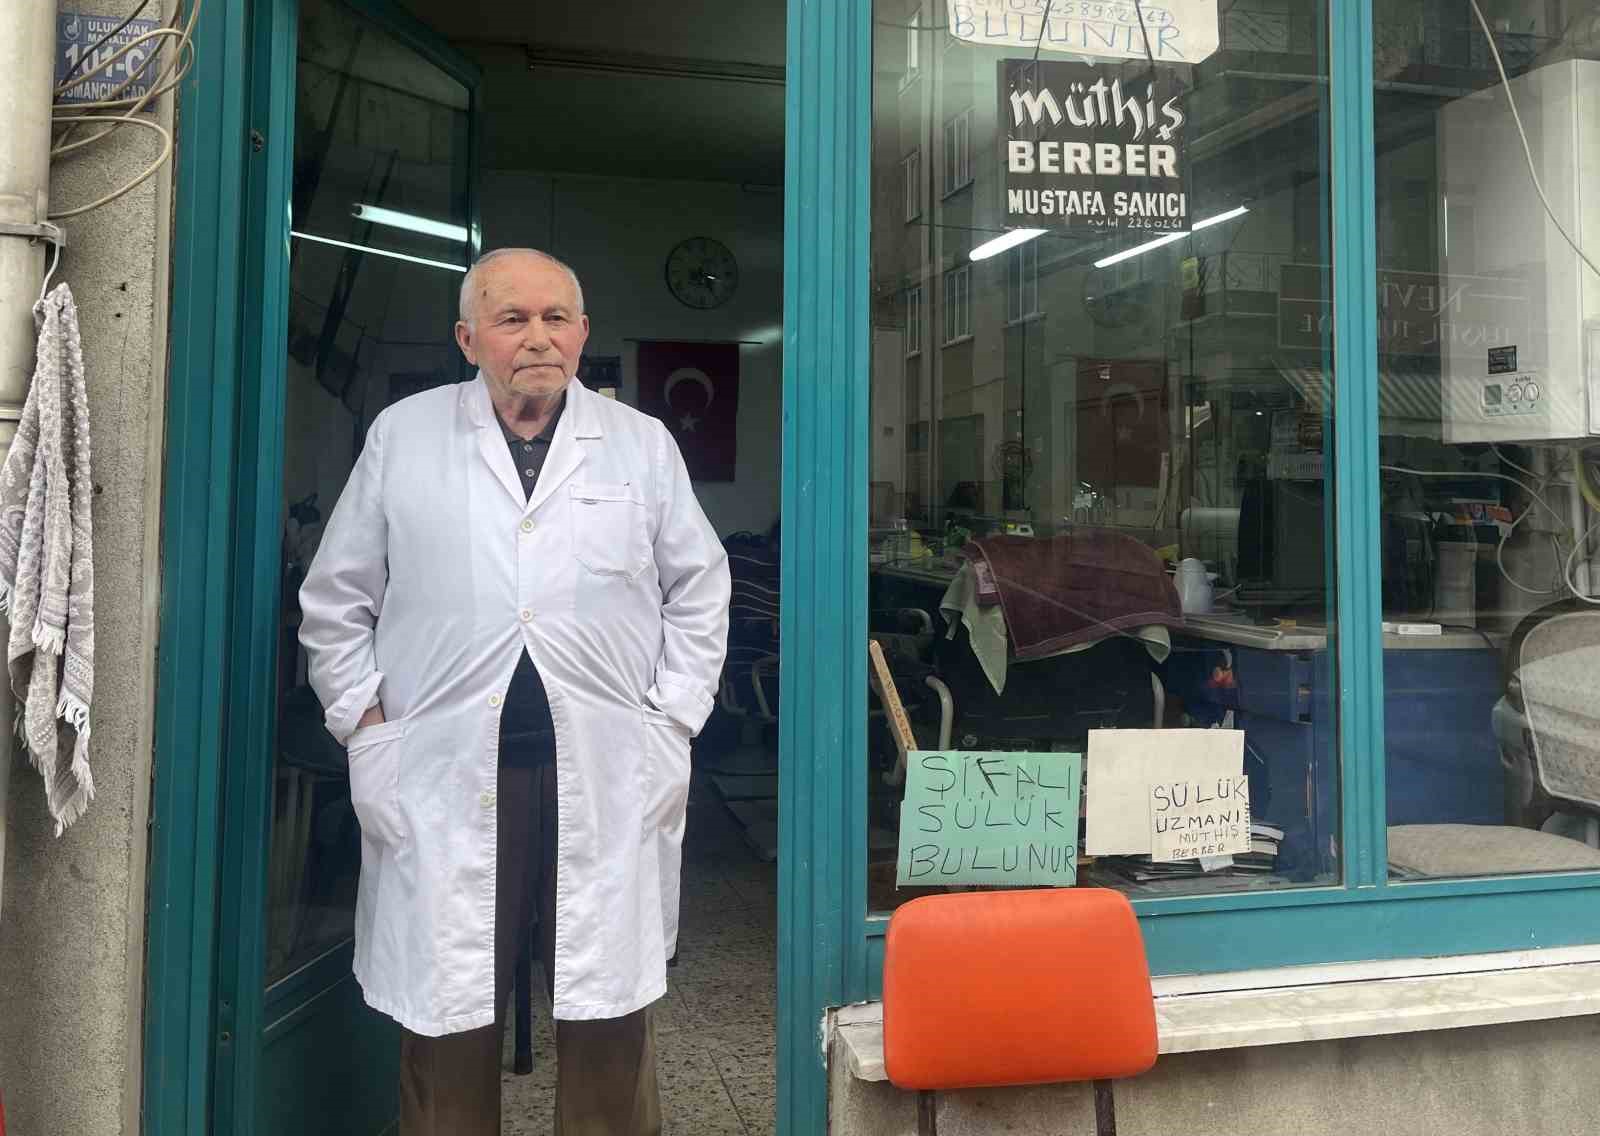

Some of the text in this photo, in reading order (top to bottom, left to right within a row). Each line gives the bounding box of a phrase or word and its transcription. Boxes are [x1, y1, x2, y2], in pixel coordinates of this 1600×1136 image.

[954, 3, 1184, 58] BULUNUR
[65, 43, 145, 81] 101-C
[58, 80, 120, 100] SMANCI
[1008, 140, 1179, 178] BERBER
[1007, 188, 1187, 217] MUSTAFA SAKICI
[1154, 777, 1247, 812] SÜLÜK
[918, 794, 1065, 832] SÜLÜK
[1156, 809, 1240, 834] UZMANI
[908, 842, 1077, 881] BULUNUR
[1172, 842, 1225, 859] BERBER
